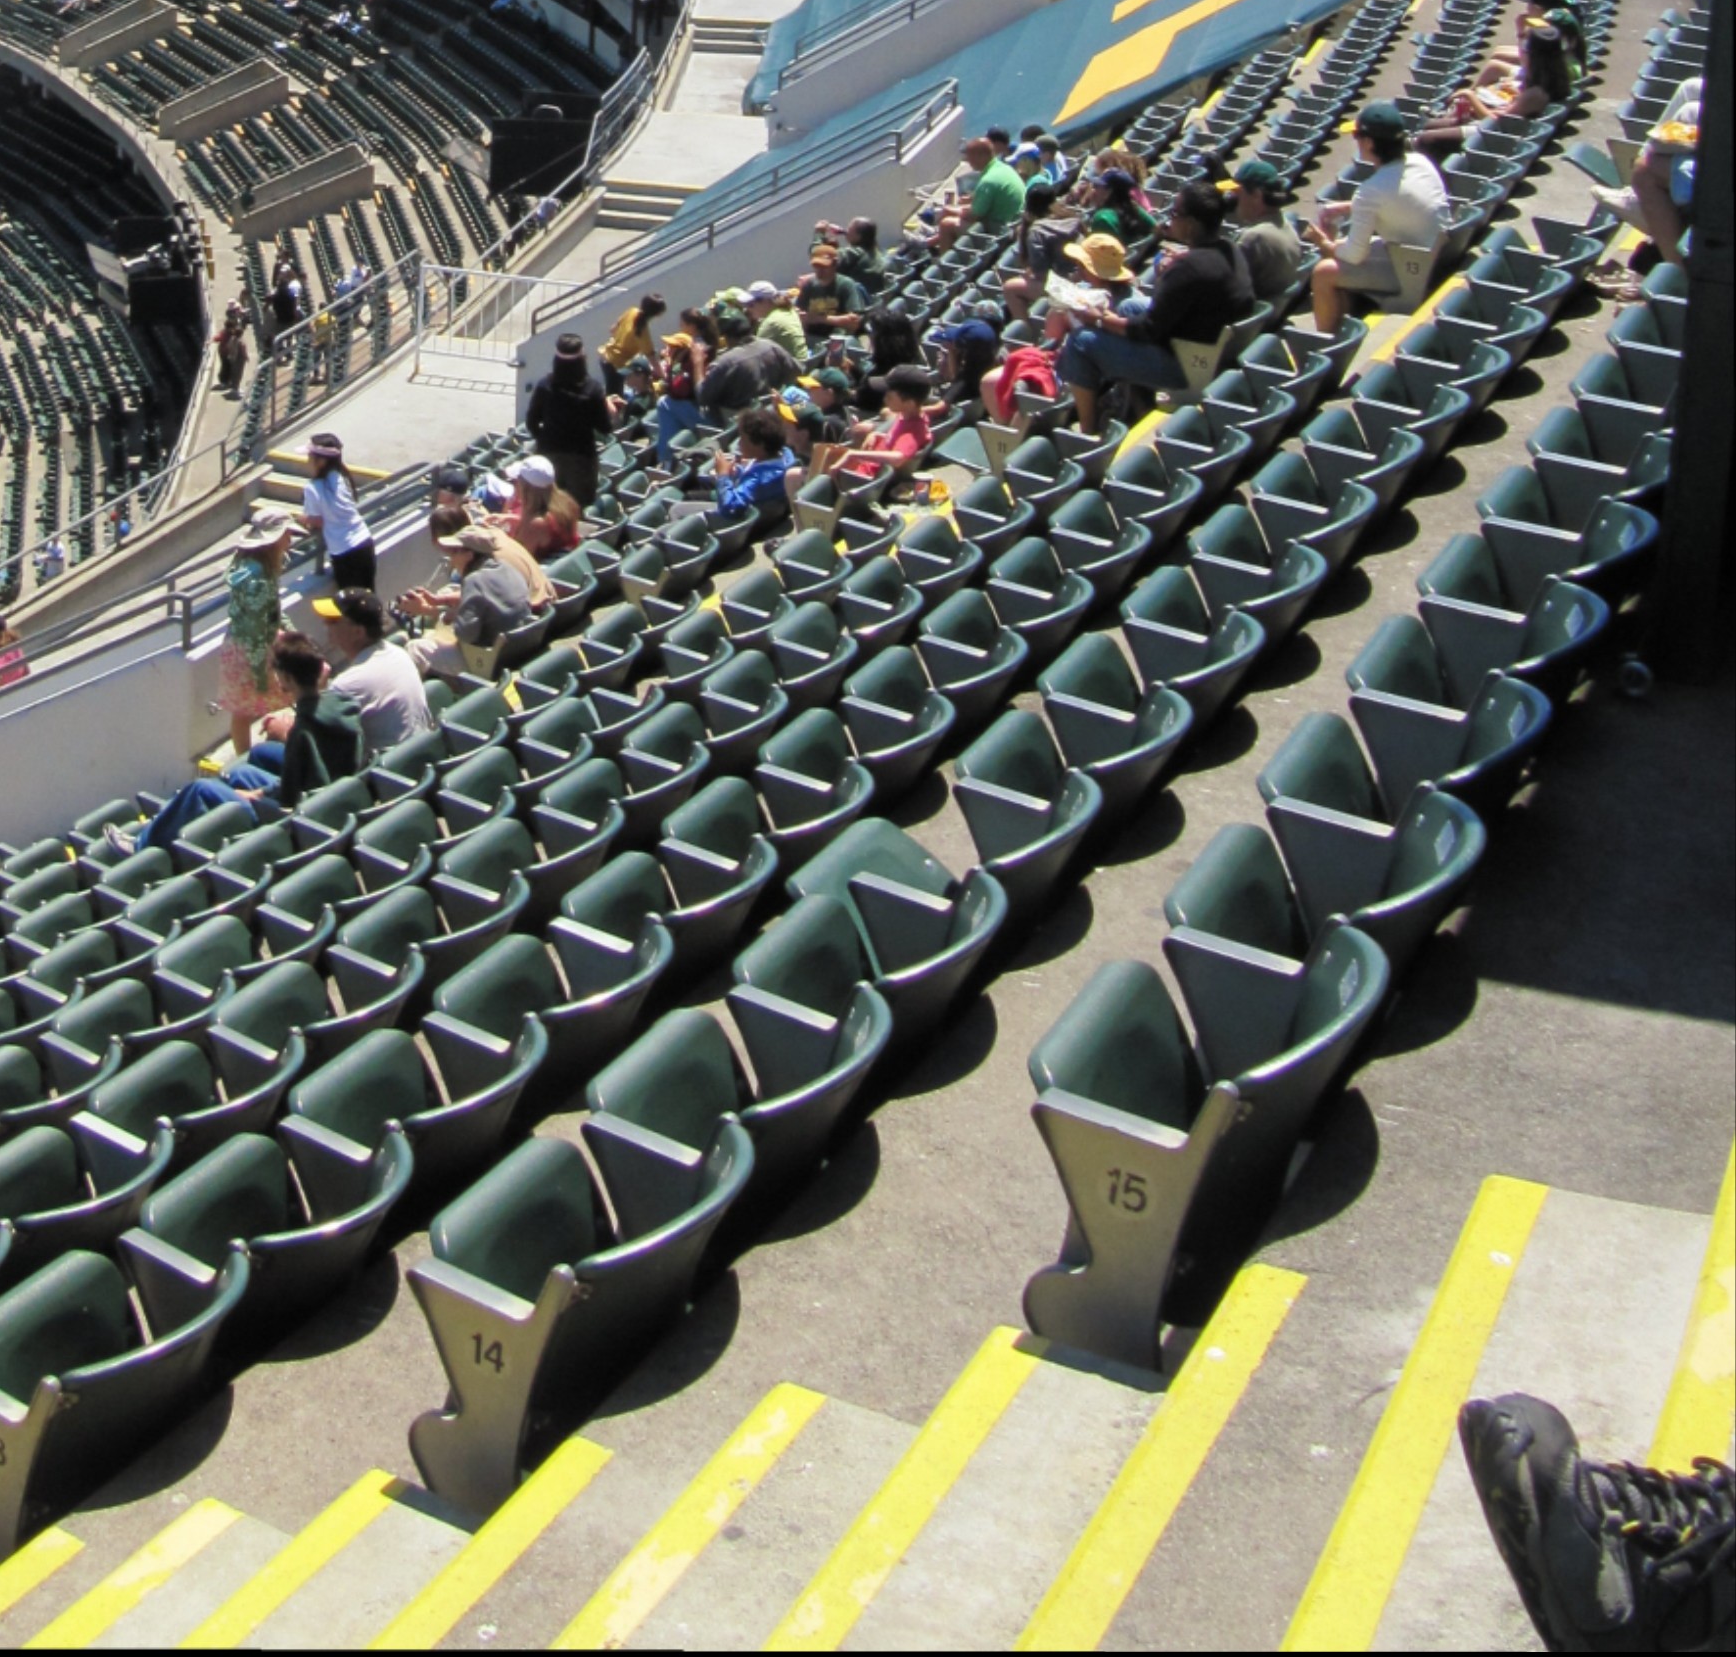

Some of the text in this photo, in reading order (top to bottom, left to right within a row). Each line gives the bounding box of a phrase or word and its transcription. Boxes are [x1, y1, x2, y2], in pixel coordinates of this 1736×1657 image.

[1405, 261, 1420, 275] 13
[1106, 1168, 1148, 1214] 15
[470, 1333, 505, 1372] 14
